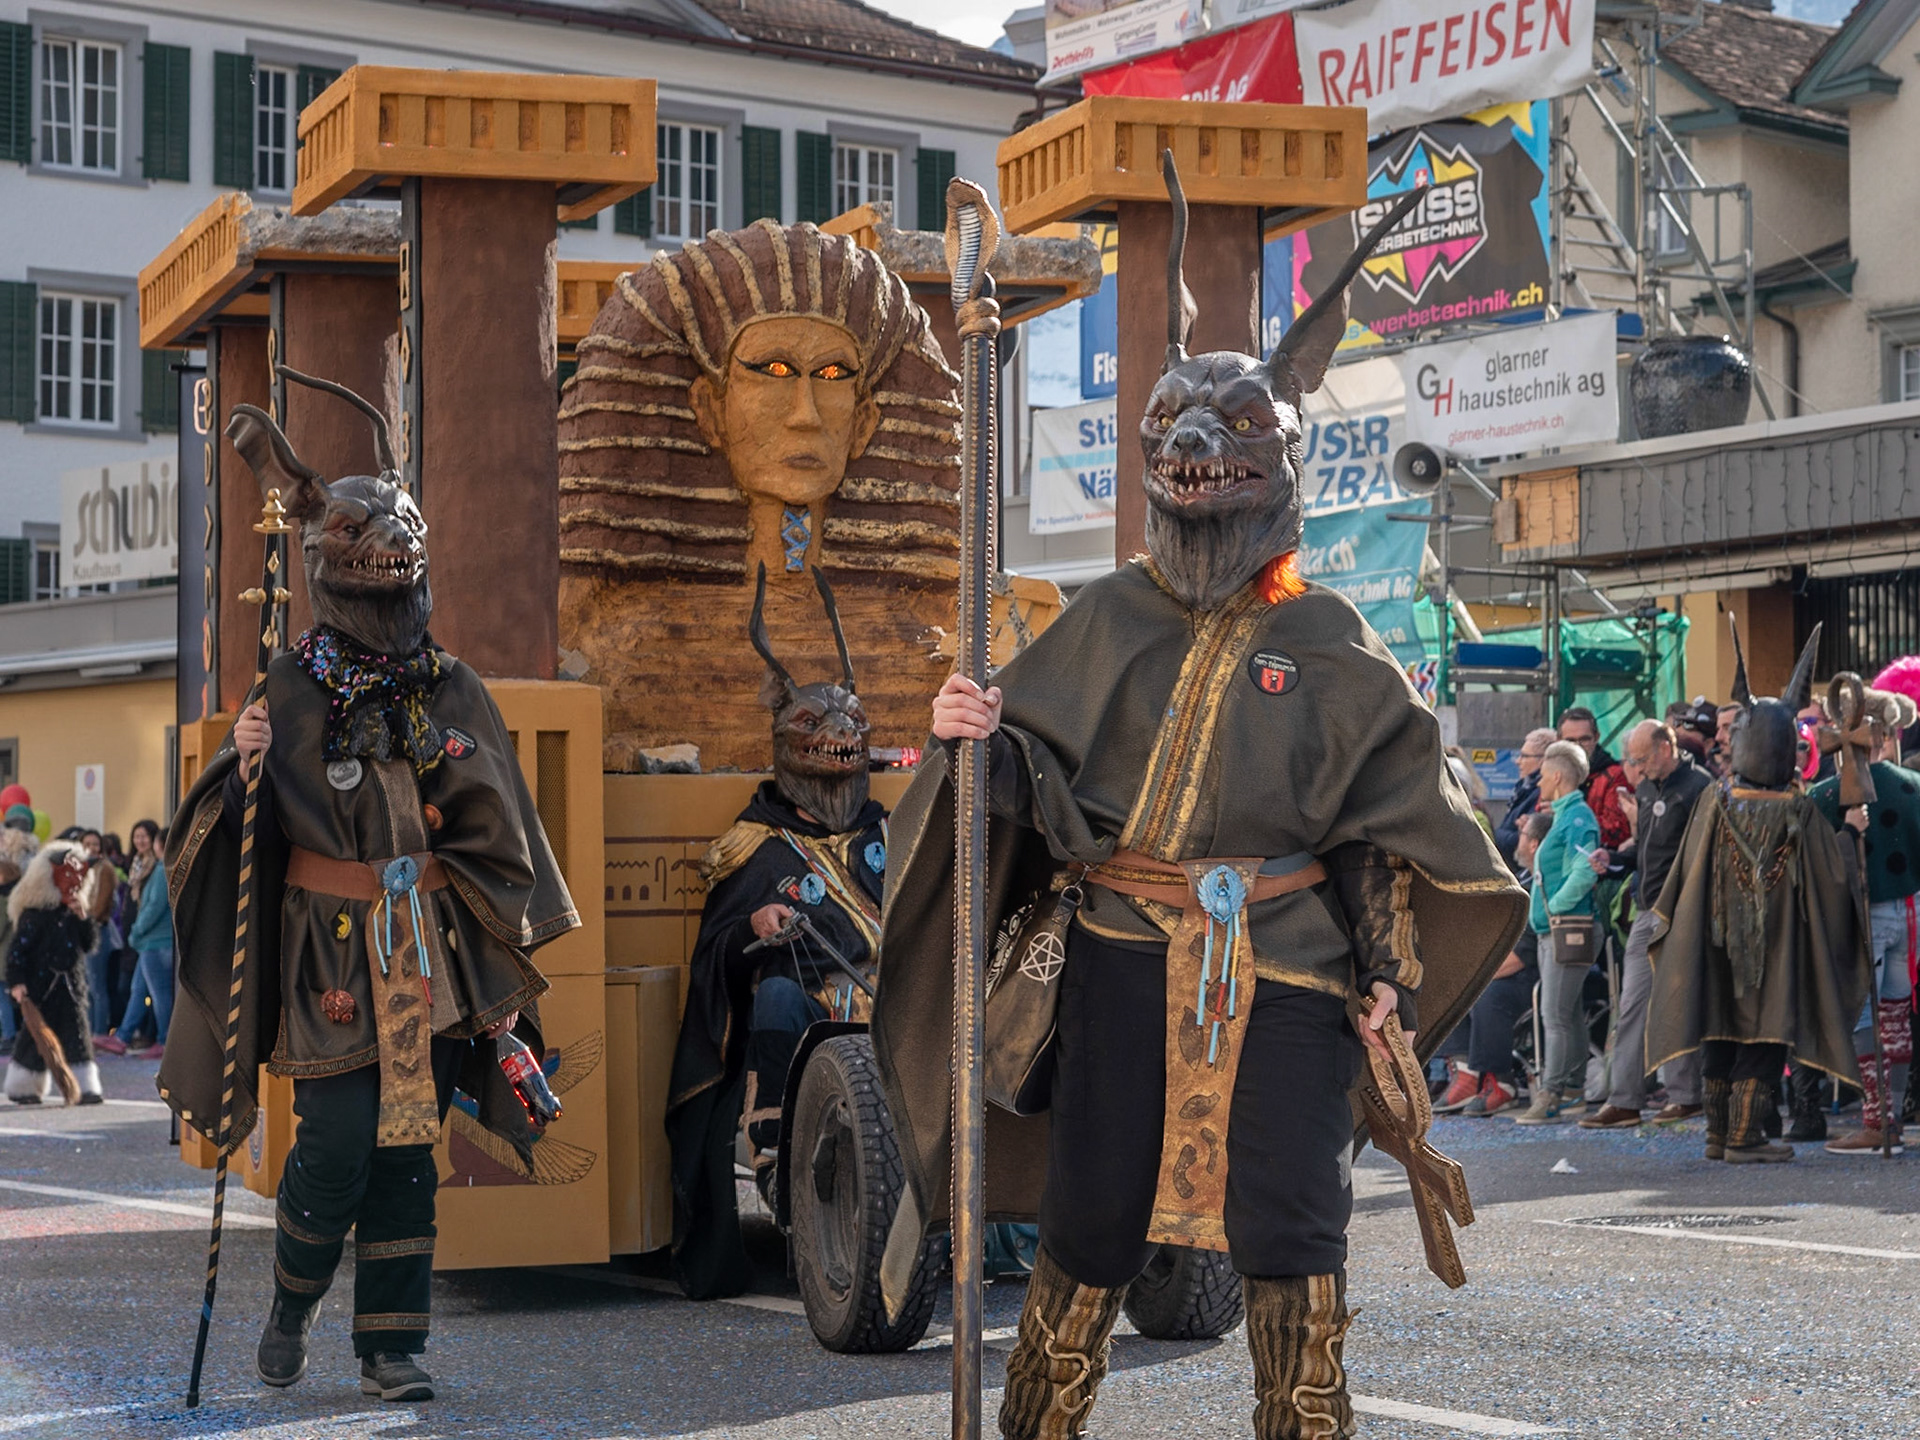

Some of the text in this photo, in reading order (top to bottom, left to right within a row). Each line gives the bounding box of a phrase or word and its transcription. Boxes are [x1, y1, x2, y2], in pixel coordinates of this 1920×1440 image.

[1318, 0, 1572, 107] RAIFFEISEN
[1224, 75, 1250, 101] AG
[1358, 180, 1478, 237] SWISS
[1371, 217, 1480, 254] ERBETECHNIK
[1093, 351, 1117, 385] Fis
[1485, 348, 1549, 382] glarner
[1459, 371, 1605, 412] haustechnik ag
[1448, 414, 1565, 447] glarner-haustechnik.ch
[1304, 461, 1410, 511] ZBA
[1393, 575, 1412, 599] AG
